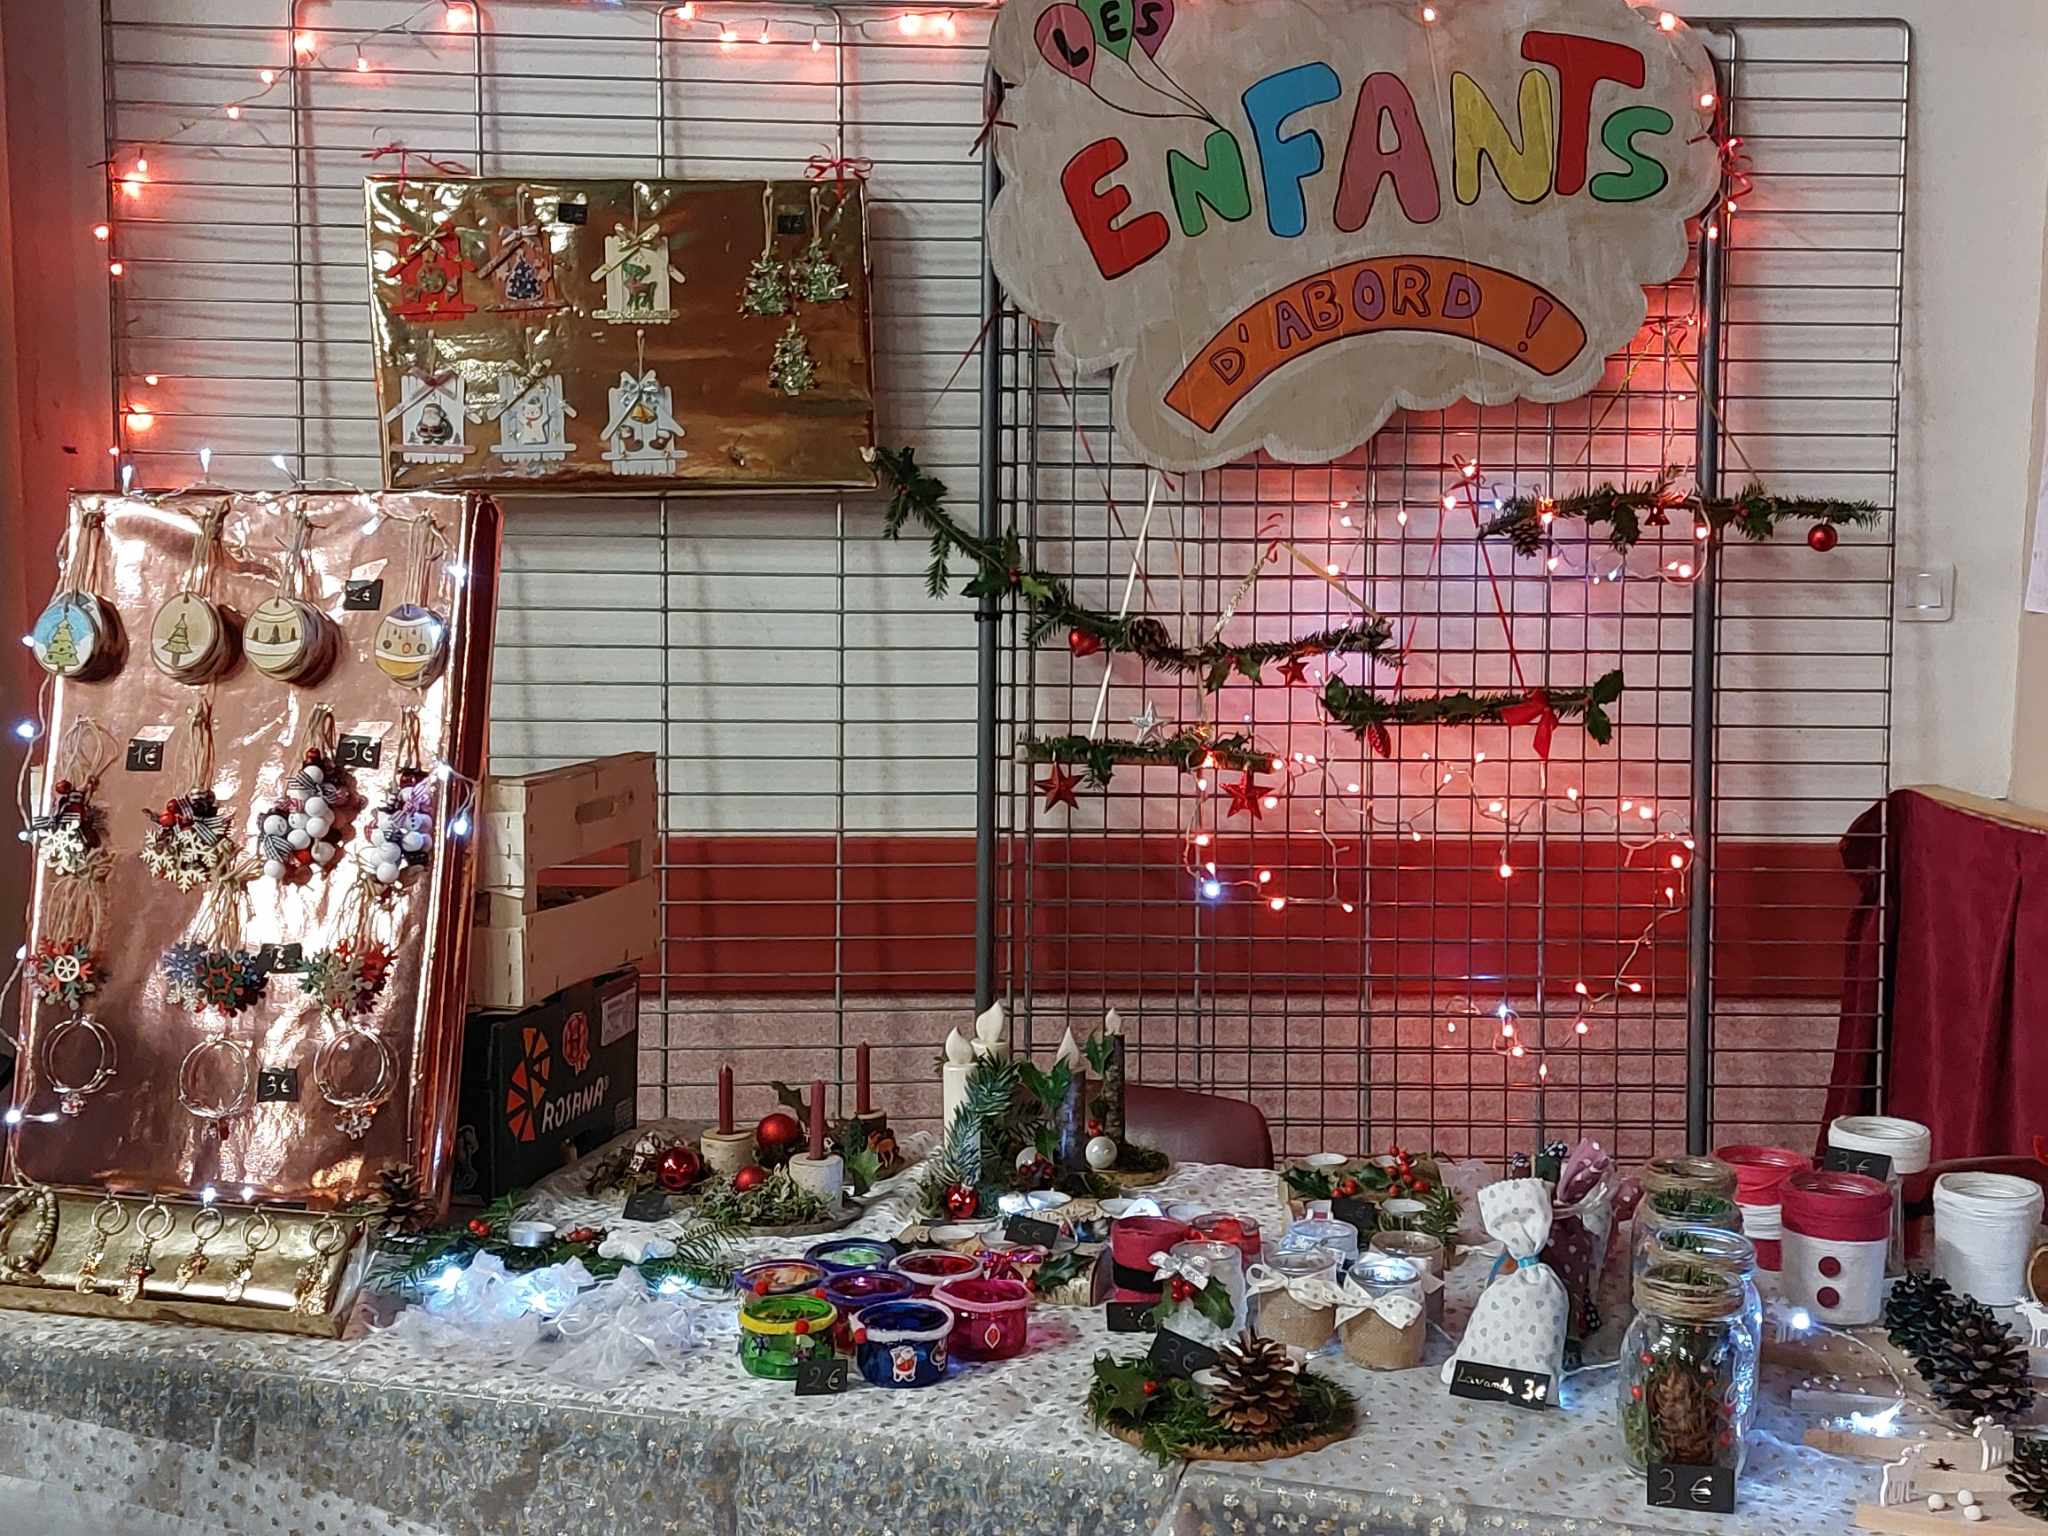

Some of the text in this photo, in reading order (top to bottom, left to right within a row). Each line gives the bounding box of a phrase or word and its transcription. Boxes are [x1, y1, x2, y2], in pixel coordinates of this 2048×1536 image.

[1053, 0, 1162, 66] LES
[1060, 31, 1673, 280] ENFANTS
[1516, 296, 1553, 353] !
[342, 739, 373, 762] 3€
[264, 1075, 290, 1096] 3€
[1521, 1378, 1547, 1401] 3€
